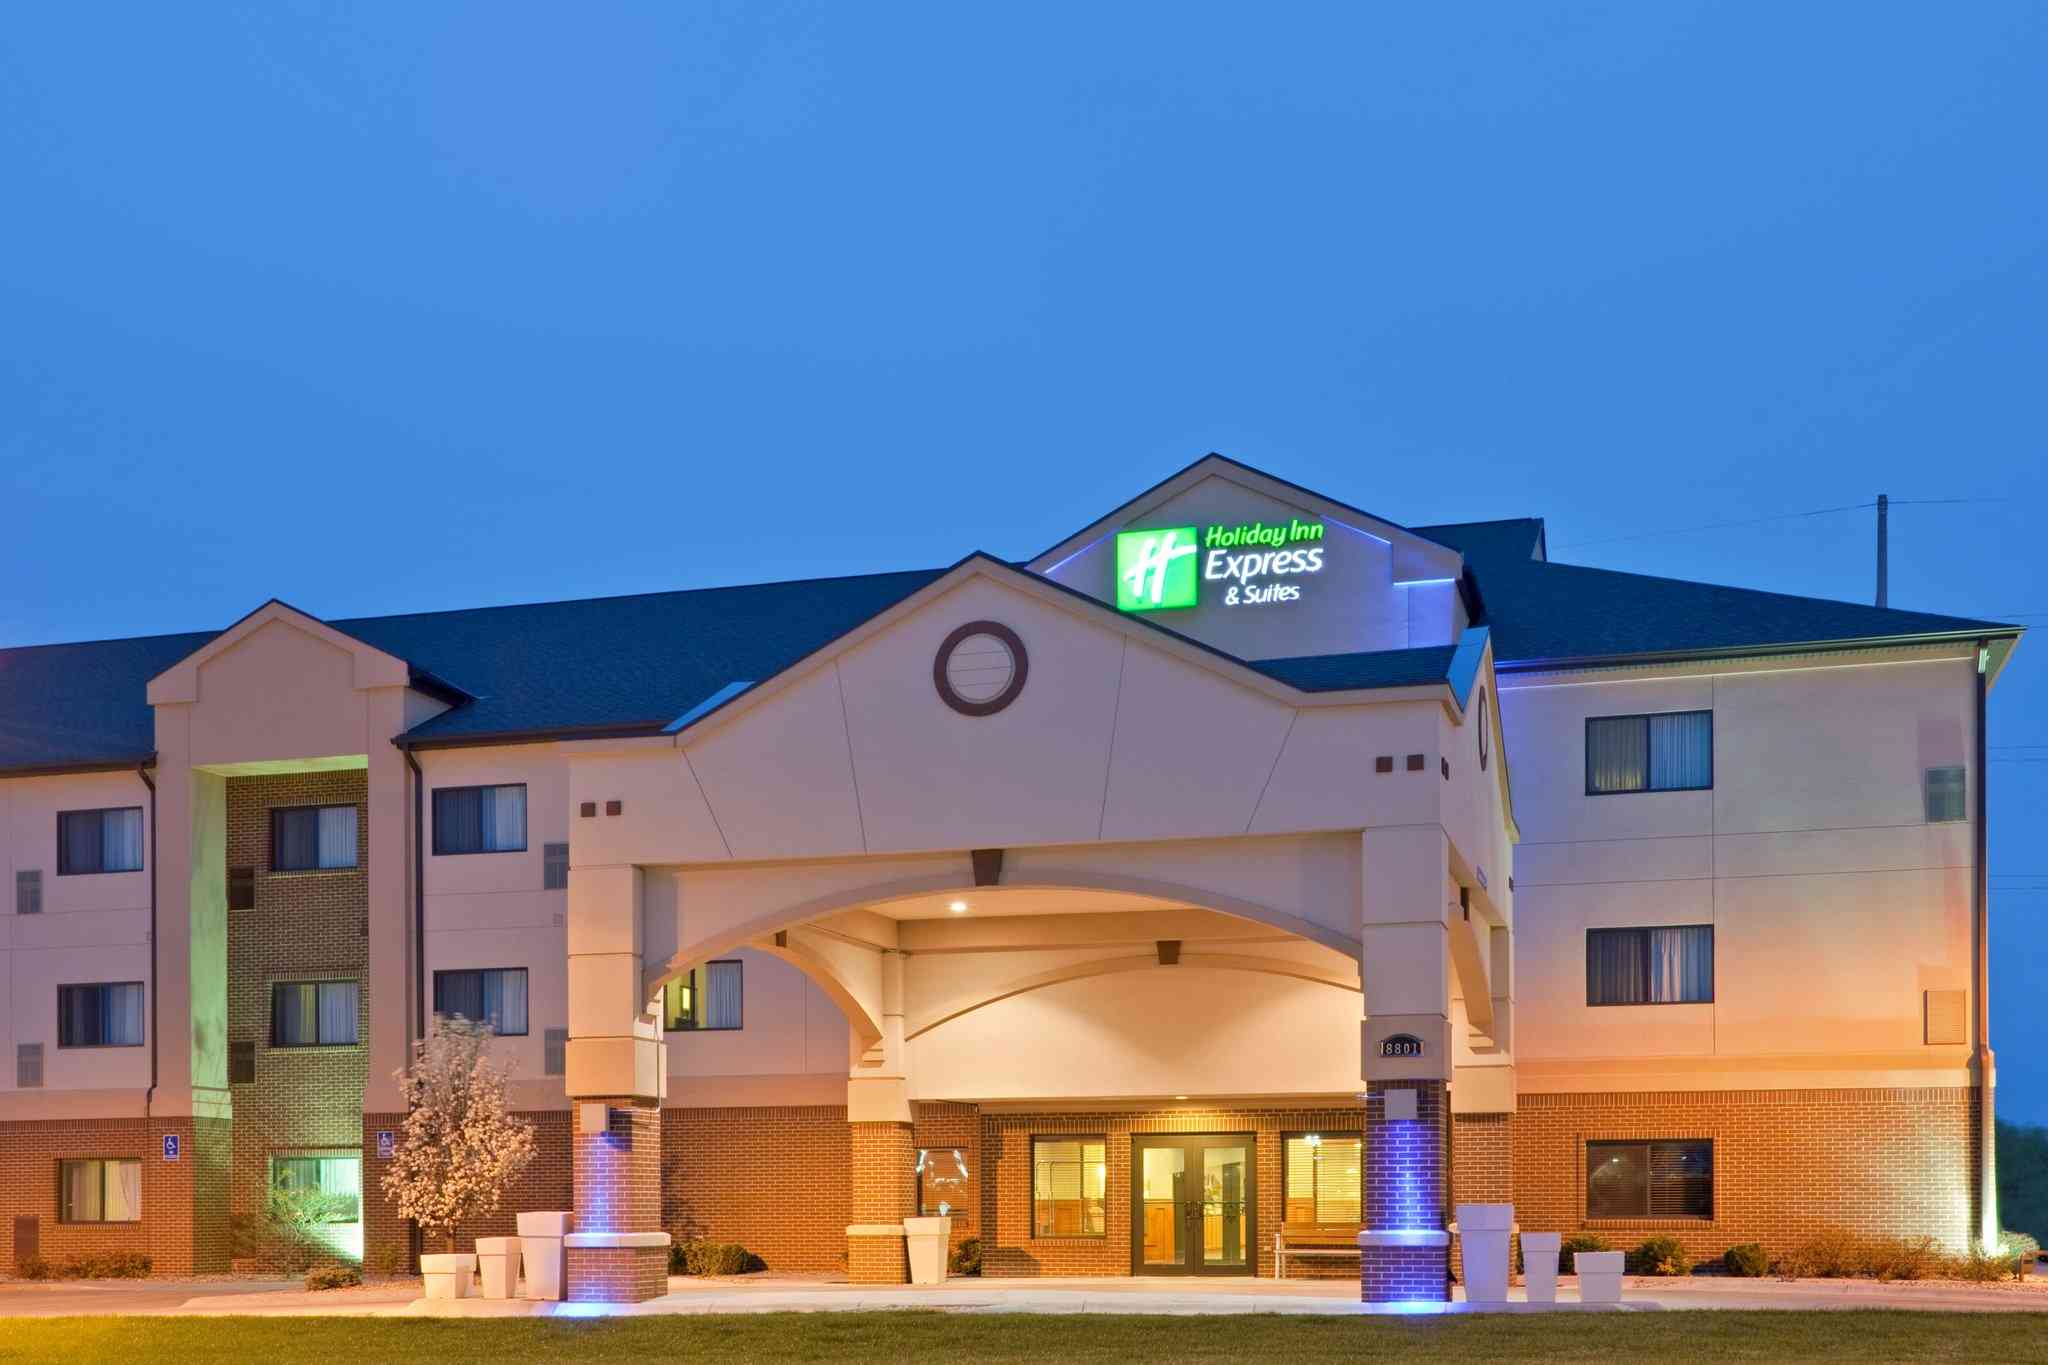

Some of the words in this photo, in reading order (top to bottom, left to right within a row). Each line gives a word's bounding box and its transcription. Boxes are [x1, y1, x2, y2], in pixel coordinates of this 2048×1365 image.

[1206, 523, 1287, 548] Holiday
[1290, 519, 1324, 541] Inn
[1205, 547, 1325, 584] Express
[1225, 586, 1239, 605] &
[1243, 583, 1300, 603] Suites
[1385, 1042, 1417, 1055] 8801
